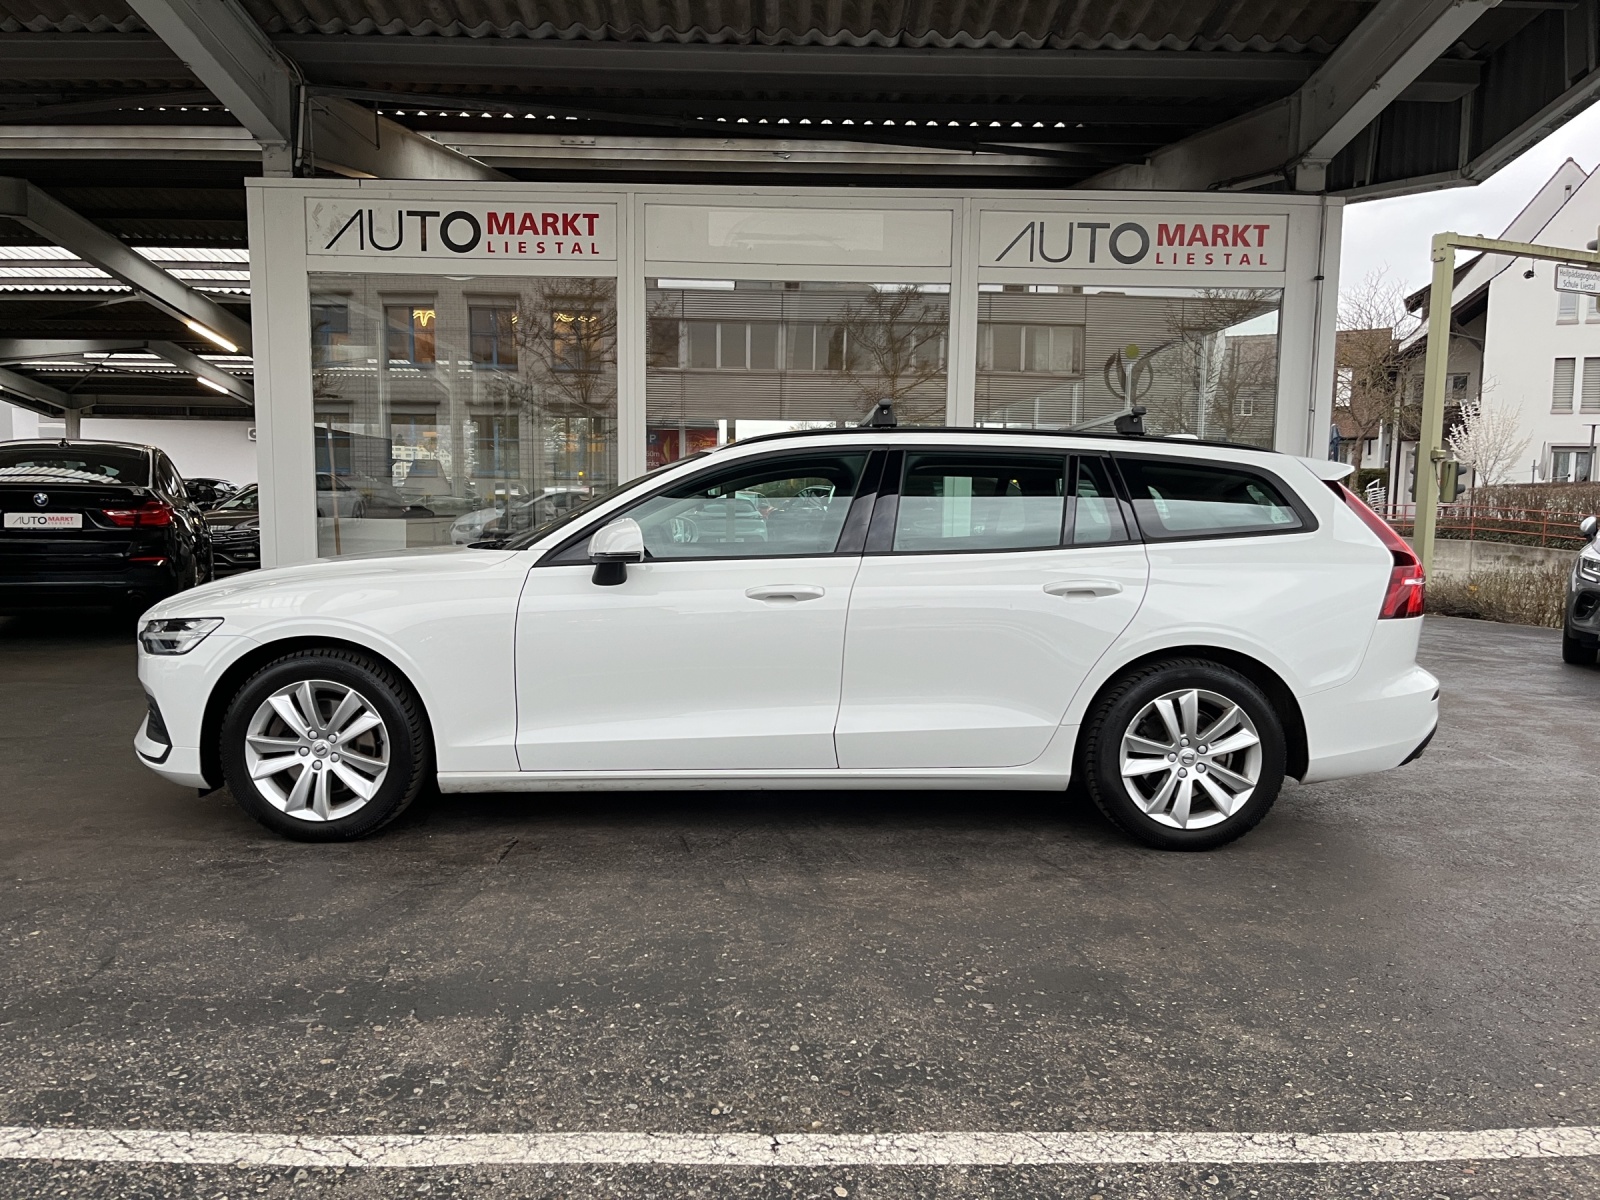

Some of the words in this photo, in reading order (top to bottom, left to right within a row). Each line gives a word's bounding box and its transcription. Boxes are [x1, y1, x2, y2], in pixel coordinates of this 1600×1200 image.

[325, 209, 482, 253] AUTO
[487, 212, 600, 236] MARKT
[487, 240, 600, 255] LIESTAL
[996, 221, 1150, 265] AUTO
[1157, 223, 1270, 248] MARKT
[1156, 252, 1268, 266] LIESTAL
[1562, 279, 1579, 289] Schule
[1580, 281, 1596, 291] Liestal
[13, 516, 48, 525] AUTO
